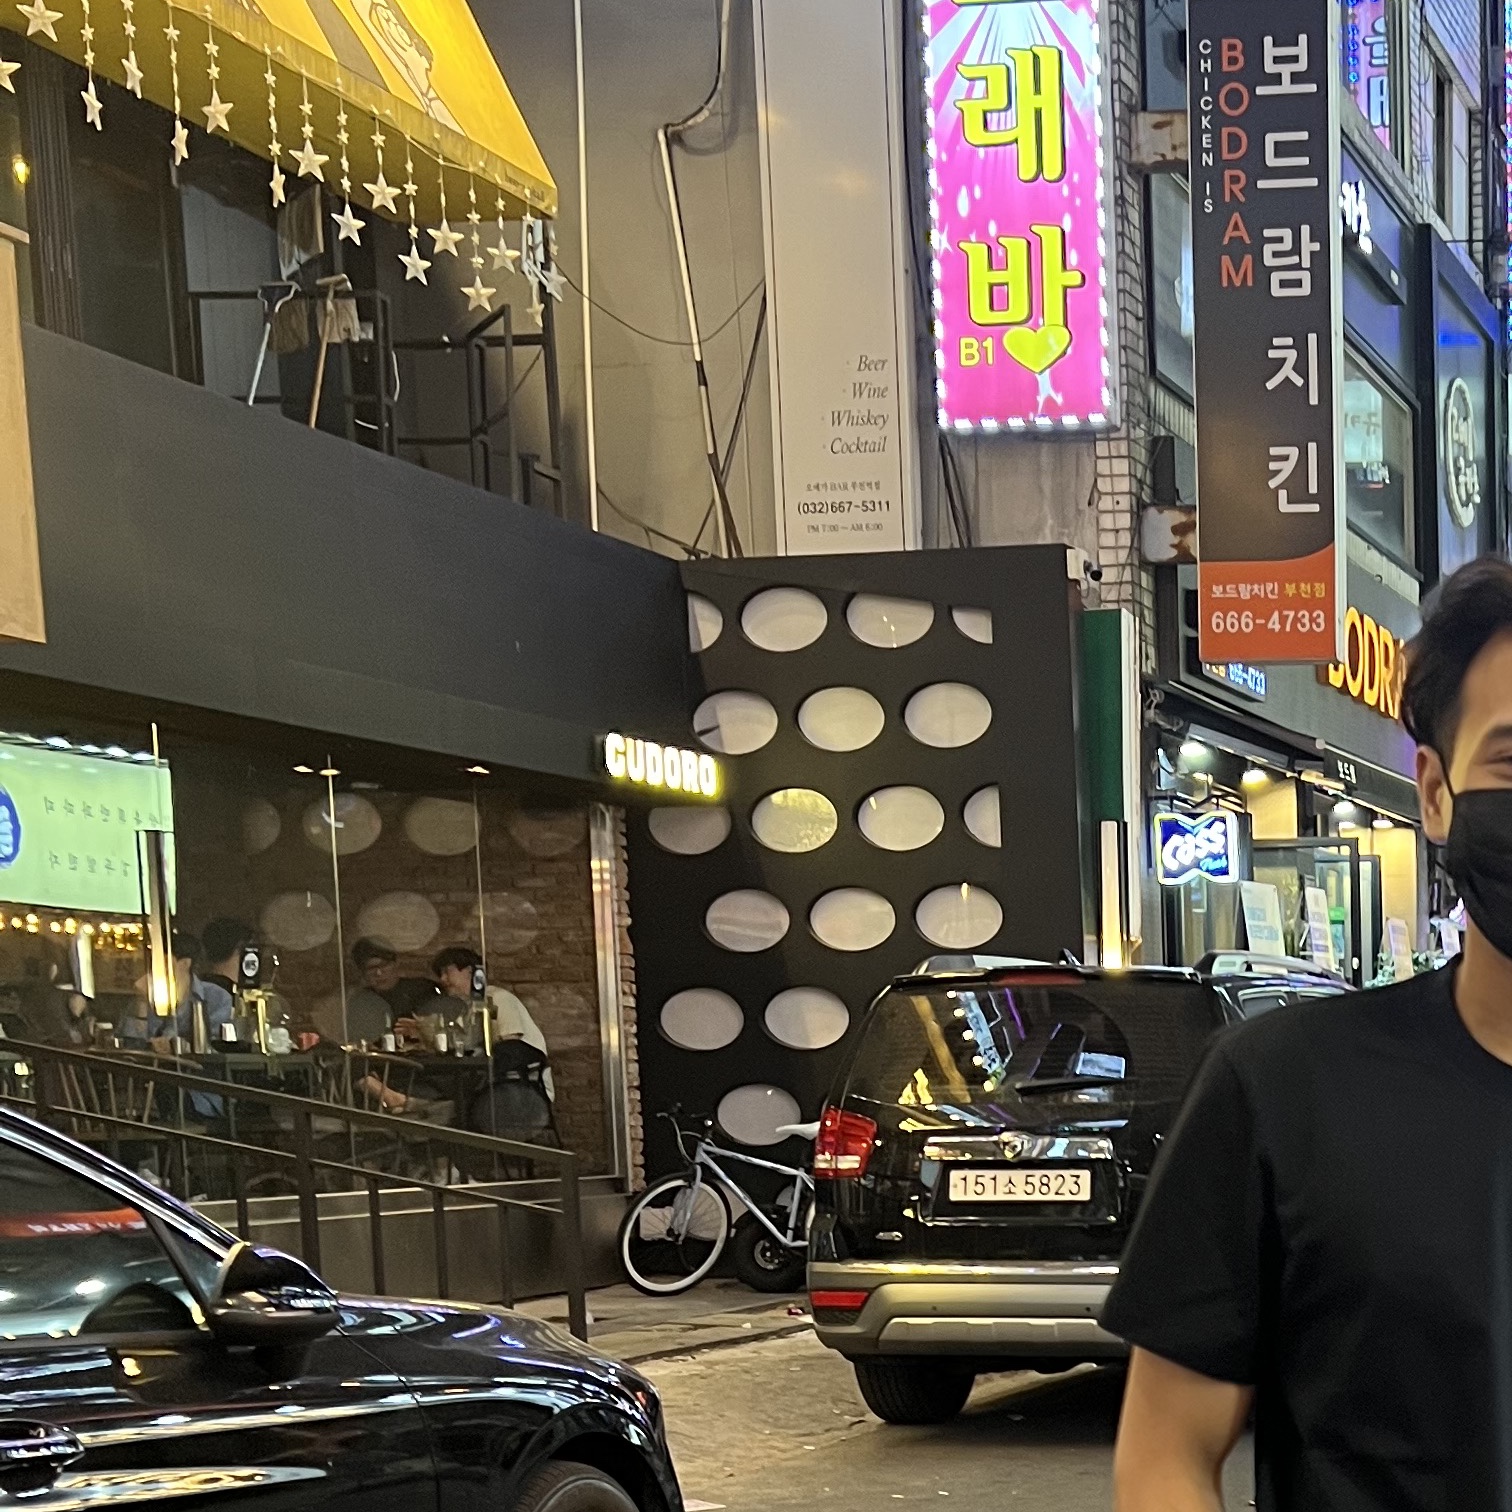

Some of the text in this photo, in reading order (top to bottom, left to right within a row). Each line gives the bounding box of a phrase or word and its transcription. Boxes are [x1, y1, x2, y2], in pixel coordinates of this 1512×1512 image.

[1198, 38, 1214, 214] CHICKEN IS
[1218, 37, 1254, 288] BODRAM
[1255, 33, 1321, 514] 보드람치킨
[959, 336, 994, 367] B1
[857, 354, 888, 372] Beer
[852, 382, 889, 400] Wine
[831, 410, 890, 431] Whiskey
[830, 436, 888, 455] Cocktail
[797, 499, 890, 516] (032)667-5311
[1211, 609, 1326, 633] 666-4733
